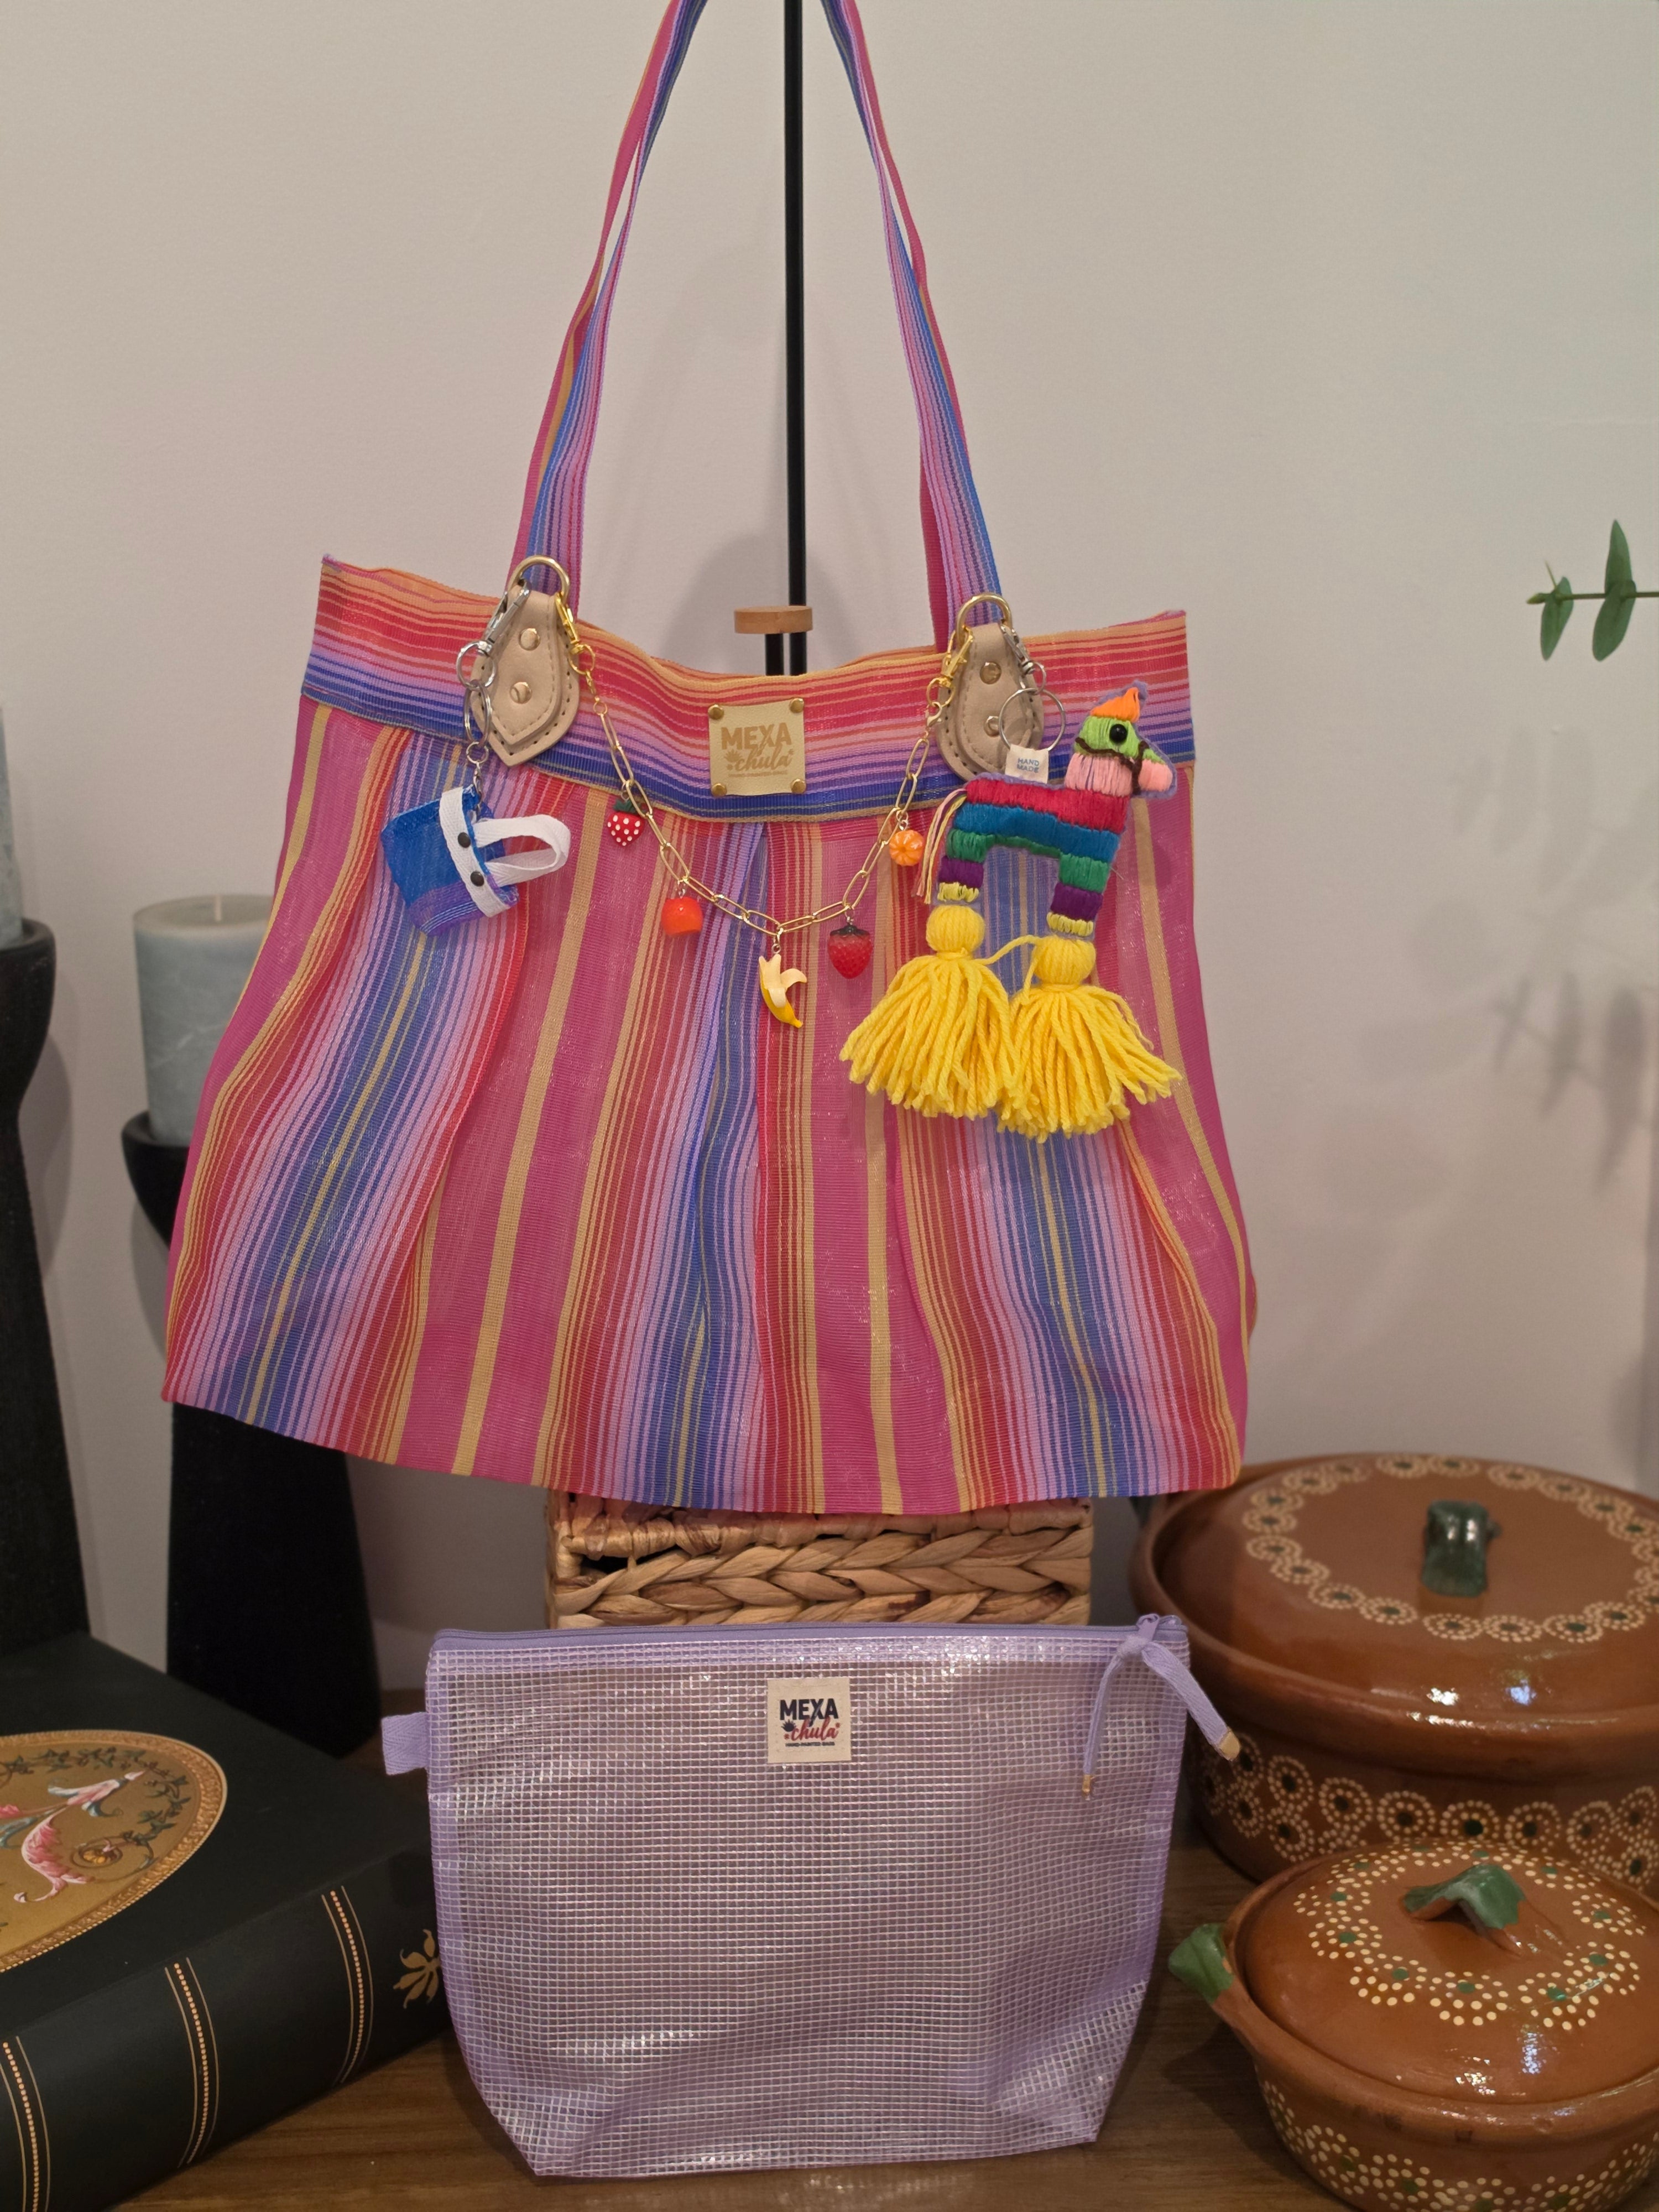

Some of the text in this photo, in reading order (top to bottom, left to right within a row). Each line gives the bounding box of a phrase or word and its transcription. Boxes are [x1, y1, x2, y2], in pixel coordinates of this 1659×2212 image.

[721, 722, 791, 753] MEXA
[735, 742, 792, 770] chula
[1017, 764, 1039, 773] MADE
[1018, 758, 1040, 766] HAND
[780, 1698, 838, 1725] MEXA
[791, 1717, 839, 1741] chula
